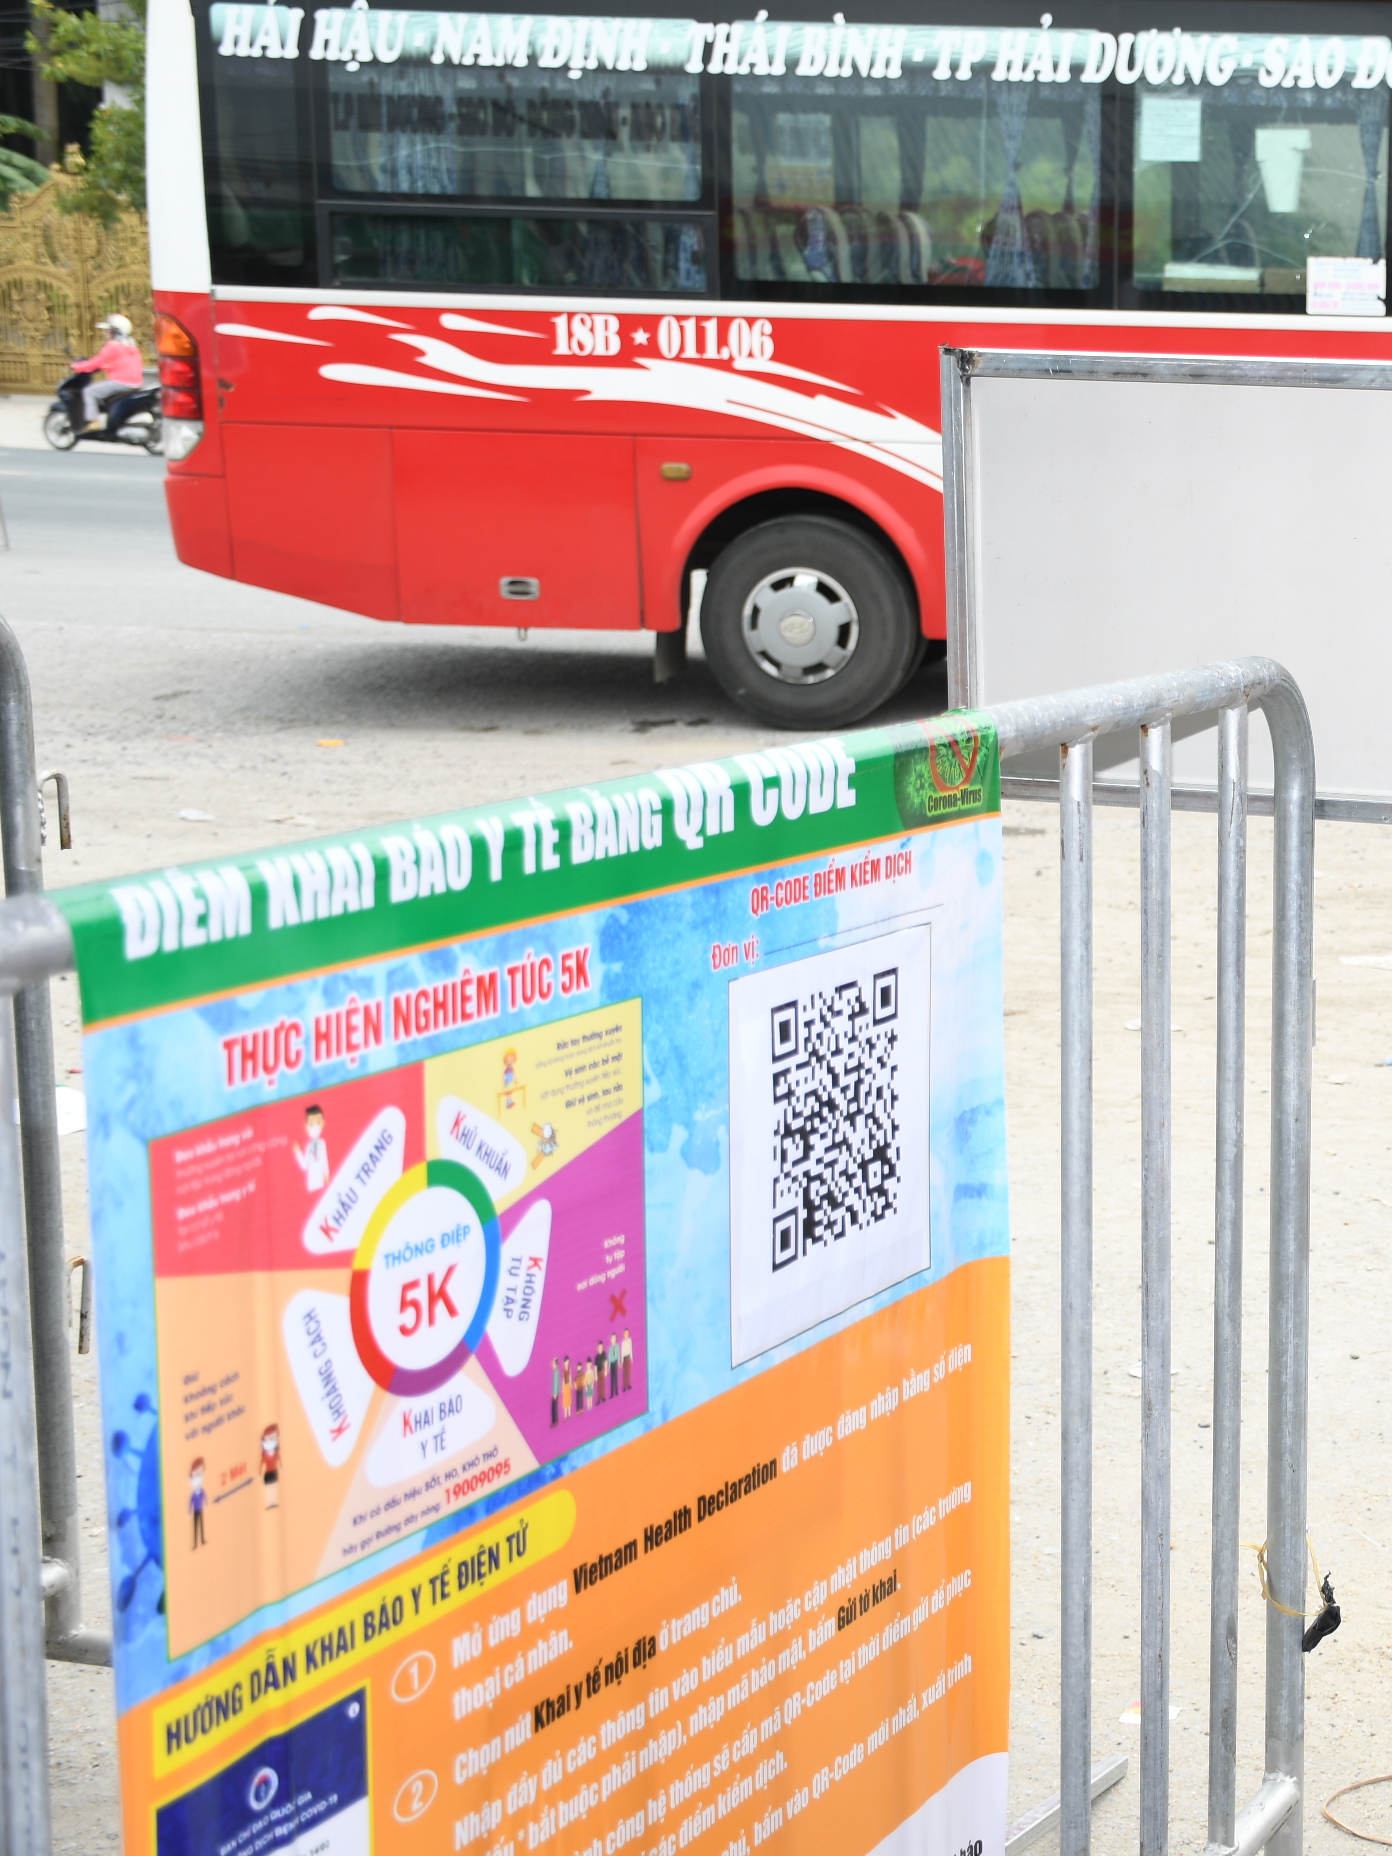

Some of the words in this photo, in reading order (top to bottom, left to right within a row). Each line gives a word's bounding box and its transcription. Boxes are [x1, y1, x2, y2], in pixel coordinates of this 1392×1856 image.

[309, 0, 409, 71] HẬU
[430, 13, 533, 67] NAM
[537, 16, 652, 79] ĐỊNH
[684, 9, 792, 76] THÁI
[795, 12, 908, 78] BÌNH
[932, 29, 987, 81] TP
[991, 12, 1077, 83] HẢI
[1080, 27, 1237, 86] DƯƠNG
[1258, 37, 1345, 89] SAO
[551, 312, 621, 356] 18B
[658, 315, 775, 361] 011.06
[256, 843, 375, 929] KHAI
[475, 817, 505, 882] Y
[656, 762, 735, 850] QR
[735, 740, 856, 827] CODE
[927, 787, 982, 814] Corona-Virus
[750, 875, 810, 916] QR-CODE
[814, 858, 846, 899] ĐIỂM
[850, 849, 881, 889] KIỂM
[885, 850, 912, 883] DỊCH
[711, 942, 738, 970] Đơn
[744, 934, 759, 965] vị:
[223, 1020, 302, 1087] THỰC
[314, 996, 382, 1064] HIỆN
[393, 968, 499, 1041] NGHIÊM
[507, 949, 553, 1009] TÚC
[560, 946, 590, 997] 5K
[450, 1110, 479, 1151] KHỬ
[475, 1139, 512, 1181] KHUẨN
[319, 1187, 360, 1243] KHẨU
[355, 1129, 394, 1187] TRANG
[384, 1238, 436, 1270] THÔNG
[440, 1223, 471, 1250] ĐIỆP
[506, 1255, 522, 1277] TỤ
[398, 1262, 460, 1338] 5K
[503, 1287, 518, 1320] TẬP
[518, 1256, 543, 1322] KHÔNG
[303, 1307, 329, 1358] CÁCH
[317, 1359, 350, 1443] KHOẢNG
[402, 1405, 434, 1438] KHAI
[438, 1393, 463, 1420] BÁO
[421, 1439, 428, 1459] Y
[433, 1428, 447, 1453] TẾ
[445, 1458, 512, 1504] 19009095
[452, 1622, 483, 1669] Mở
[488, 1608, 521, 1648] ứng
[527, 1579, 568, 1623] dụng
[573, 1538, 638, 1595] Vietnam
[643, 1504, 692, 1554] Health
[697, 1457, 777, 1524] Declaration
[782, 1441, 798, 1473] đã
[802, 1425, 833, 1461] được
[837, 1405, 867, 1440] đăng
[870, 1386, 899, 1421] nhập
[902, 1368, 930, 1402] bằng
[933, 1351, 946, 1383] số
[948, 1343, 972, 1373] điện
[166, 1681, 243, 1756] HƯỚNG
[249, 1647, 297, 1704] DẪN
[304, 1631, 356, 1687] KHAI
[363, 1595, 404, 1643] BÁO
[411, 1582, 424, 1617] Y
[428, 1557, 451, 1611] TẾ
[456, 1541, 500, 1587] ĐIỆN
[506, 1518, 529, 1564] TỬ
[455, 1799, 503, 1852] Nhập
[507, 1770, 538, 1816] đầy
[542, 1750, 563, 1791] đủ
[567, 1735, 597, 1774] các
[601, 1702, 646, 1750] thông
[648, 1686, 669, 1718] tin
[672, 1667, 699, 1702] vào
[702, 1637, 734, 1683] biểu
[736, 1617, 767, 1659] mẫu
[769, 1597, 801, 1636] hoặc
[804, 1580, 828, 1612] cập
[830, 1556, 857, 1594] nhật
[859, 1536, 892, 1574] thông
[894, 1524, 910, 1550] tin
[912, 1506, 937, 1540] (các
[938, 1481, 972, 1520] trường
[453, 1666, 501, 1721] thoại
[503, 1651, 525, 1690] cá
[527, 1629, 574, 1675] nhân.
[454, 1735, 502, 1785] Chọn
[504, 1711, 532, 1754] nút
[534, 1684, 571, 1734] Khai
[574, 1681, 584, 1711] y
[586, 1657, 604, 1699] tế
[604, 1647, 629, 1686] nội
[632, 1635, 657, 1670] địa
[659, 1620, 670, 1651] ở
[671, 1601, 710, 1644] trang
[712, 1576, 742, 1618] chủ.
